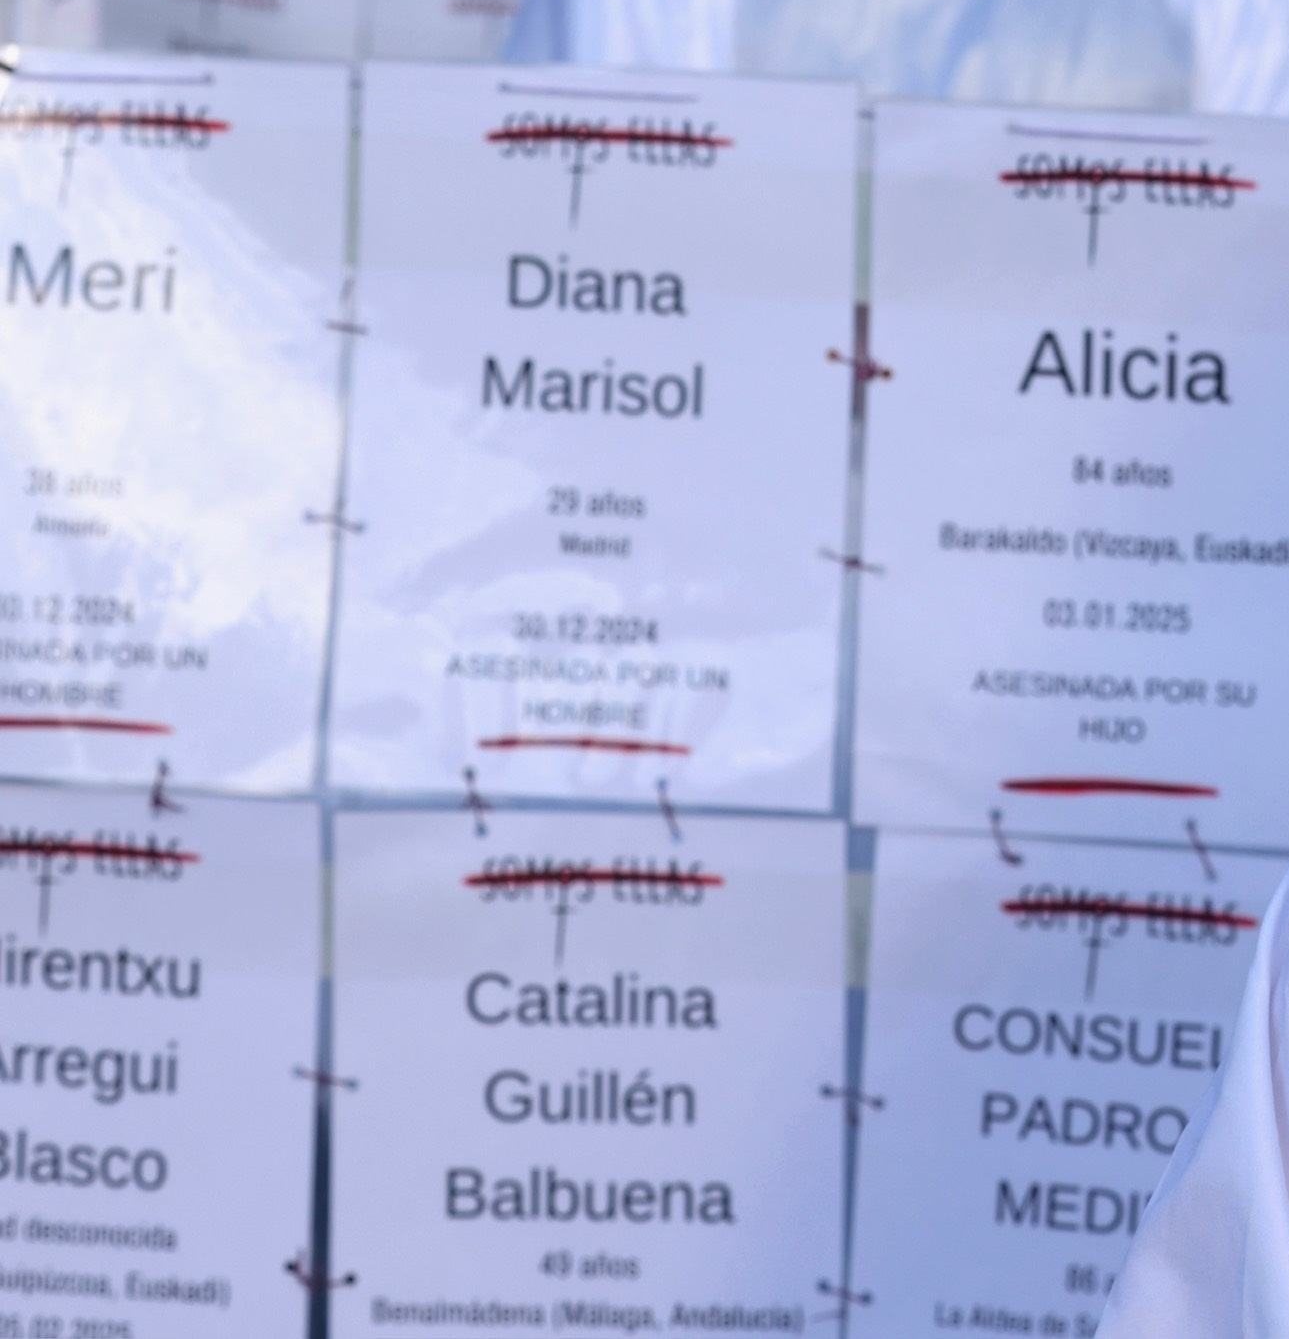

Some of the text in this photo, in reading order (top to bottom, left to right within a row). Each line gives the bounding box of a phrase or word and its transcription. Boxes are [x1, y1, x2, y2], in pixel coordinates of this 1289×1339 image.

[7, 241, 175, 312] Meri
[507, 253, 687, 317] Diana
[1018, 329, 1231, 405] Alicia
[481, 355, 704, 419] Marisol
[1072, 456, 1173, 489] 84 años
[547, 486, 647, 519] 29 años
[559, 533, 631, 558] Madrid
[939, 522, 1069, 556] Barakaldo
[1073, 529, 1186, 565] (Vizcaya,
[0, 593, 135, 628] 0.12.2024
[1043, 598, 1192, 635] 03.01.2025
[445, 651, 730, 692] ASESINADA POR UN
[972, 671, 1257, 708] ASESINADA POR SU
[524, 699, 648, 735] HOMBRE
[1078, 717, 1147, 744] HIJO
[0, 934, 201, 999] irentxu
[465, 971, 718, 1030] Catalina
[483, 1069, 696, 1126] Guillén
[445, 1167, 736, 1225] Balbuena
[994, 1178, 1151, 1238] MEDI
[22, 1216, 178, 1252] desconocida
[539, 1251, 640, 1279] 49 años
[124, 1271, 231, 1307] Euskadi)
[371, 1295, 805, 1334] Benalmádena (Málaga, Andalucía)
